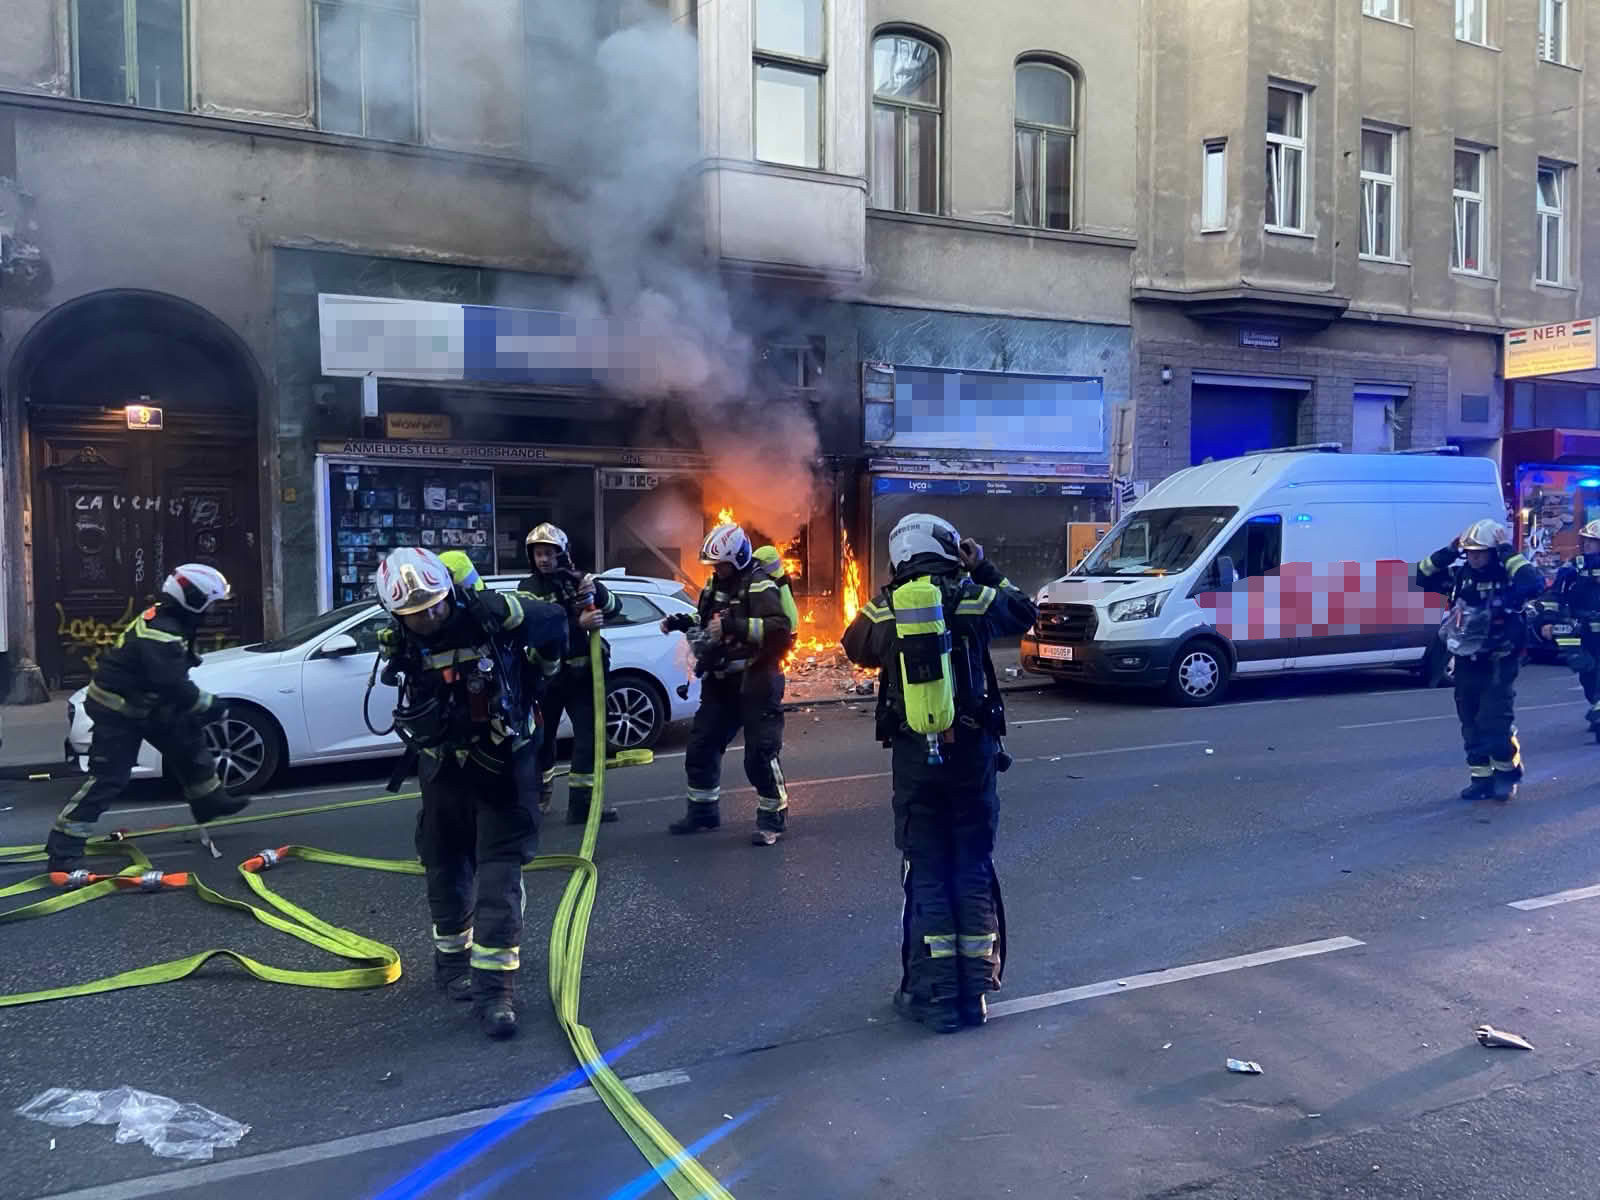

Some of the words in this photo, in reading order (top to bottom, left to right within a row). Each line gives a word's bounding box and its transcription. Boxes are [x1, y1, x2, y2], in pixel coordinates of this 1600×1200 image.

[1533, 325, 1567, 341] NER
[139, 408, 151, 423] 9
[343, 441, 449, 456] ANMELDESTELLE
[463, 447, 547, 460] GROSSHANDEL
[909, 481, 927, 490] Lyca
